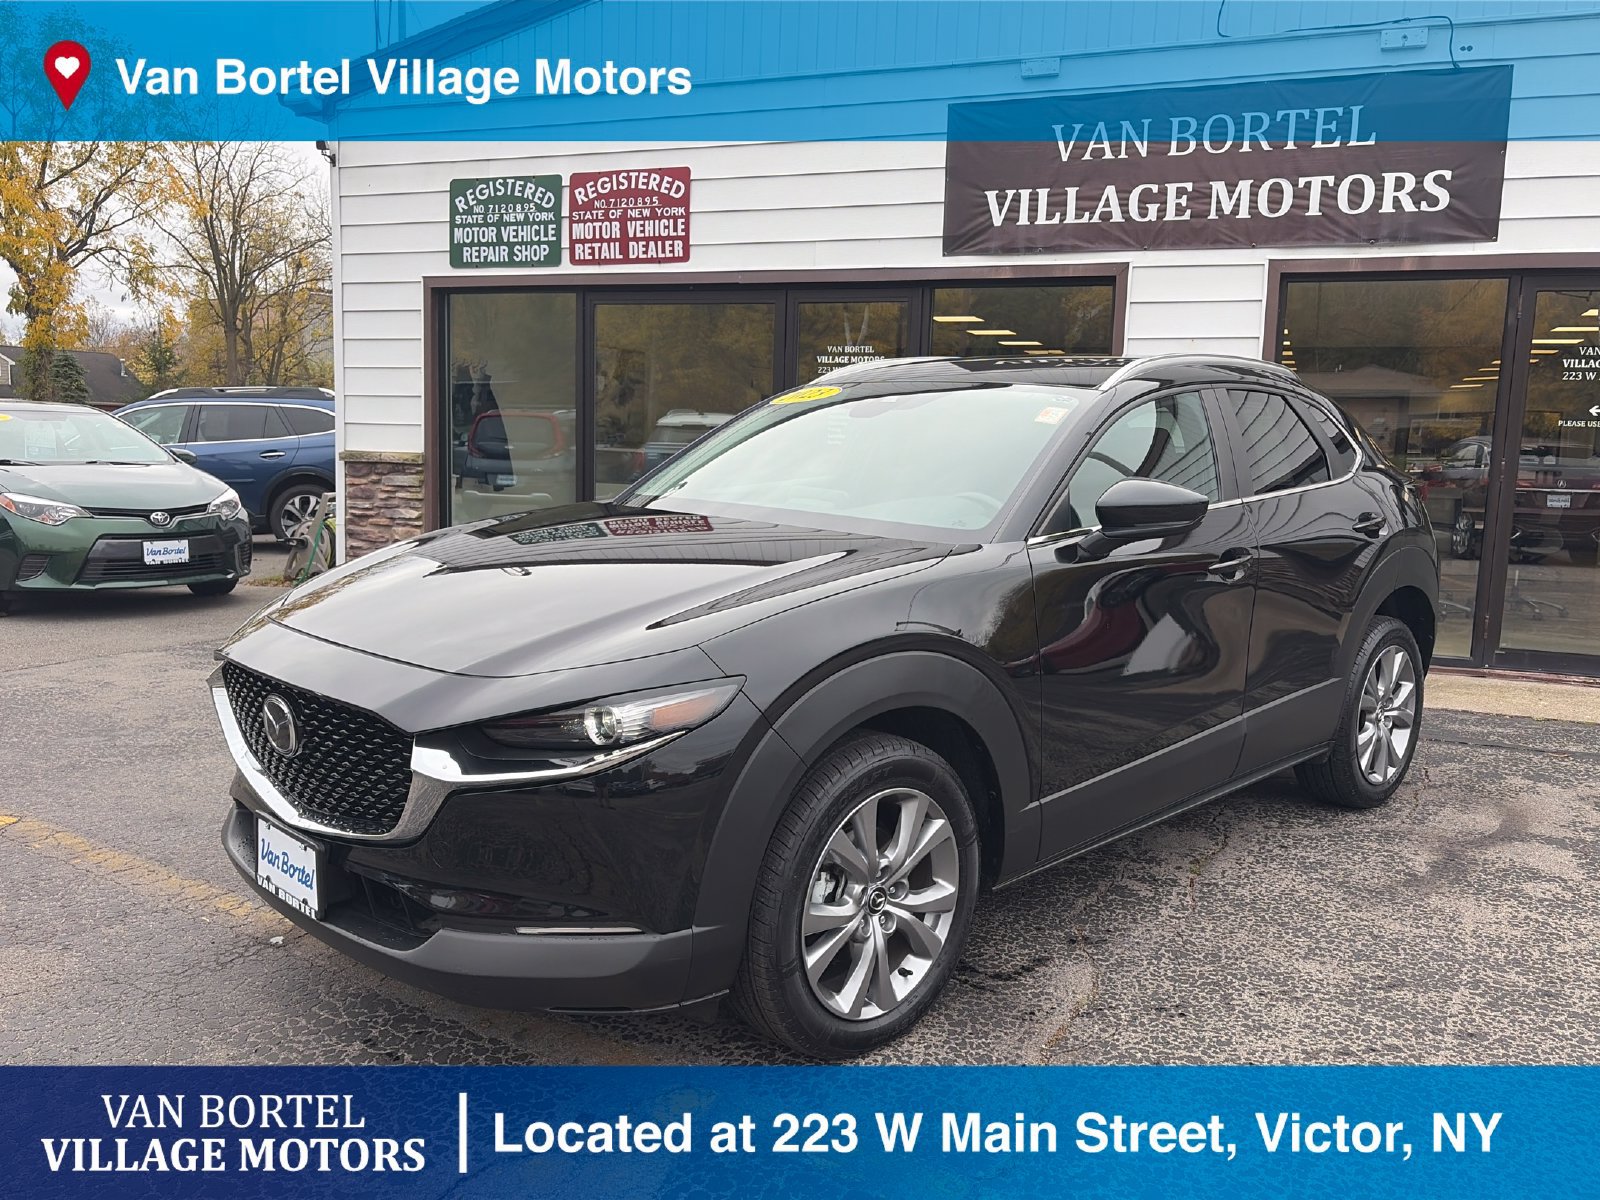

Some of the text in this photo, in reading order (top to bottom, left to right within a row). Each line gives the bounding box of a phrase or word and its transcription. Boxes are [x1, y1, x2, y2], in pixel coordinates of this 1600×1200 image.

[1052, 105, 1376, 162] VAN BORTEL
[455, 178, 555, 213] REGISTERED
[574, 172, 686, 205] REGISTERED
[984, 169, 1453, 226] VILLAGE MOTORS
[488, 203, 536, 213] 7120895
[609, 196, 659, 208] 7120895
[455, 212, 555, 224] STATE OF NEW YORK
[572, 206, 686, 220] STATE OF NEW YORK
[454, 224, 557, 244] MOTOR VEHICLE
[572, 218, 686, 240] MOTOR VEHICLE
[463, 244, 550, 263] REPAIR SHOP
[574, 239, 684, 260] RETAIL DEALER
[827, 345, 874, 353] VAN BORTEL
[816, 356, 850, 364] VILLAGE
[1562, 371, 1597, 381] 223 W
[256, 874, 277, 895] VAN
